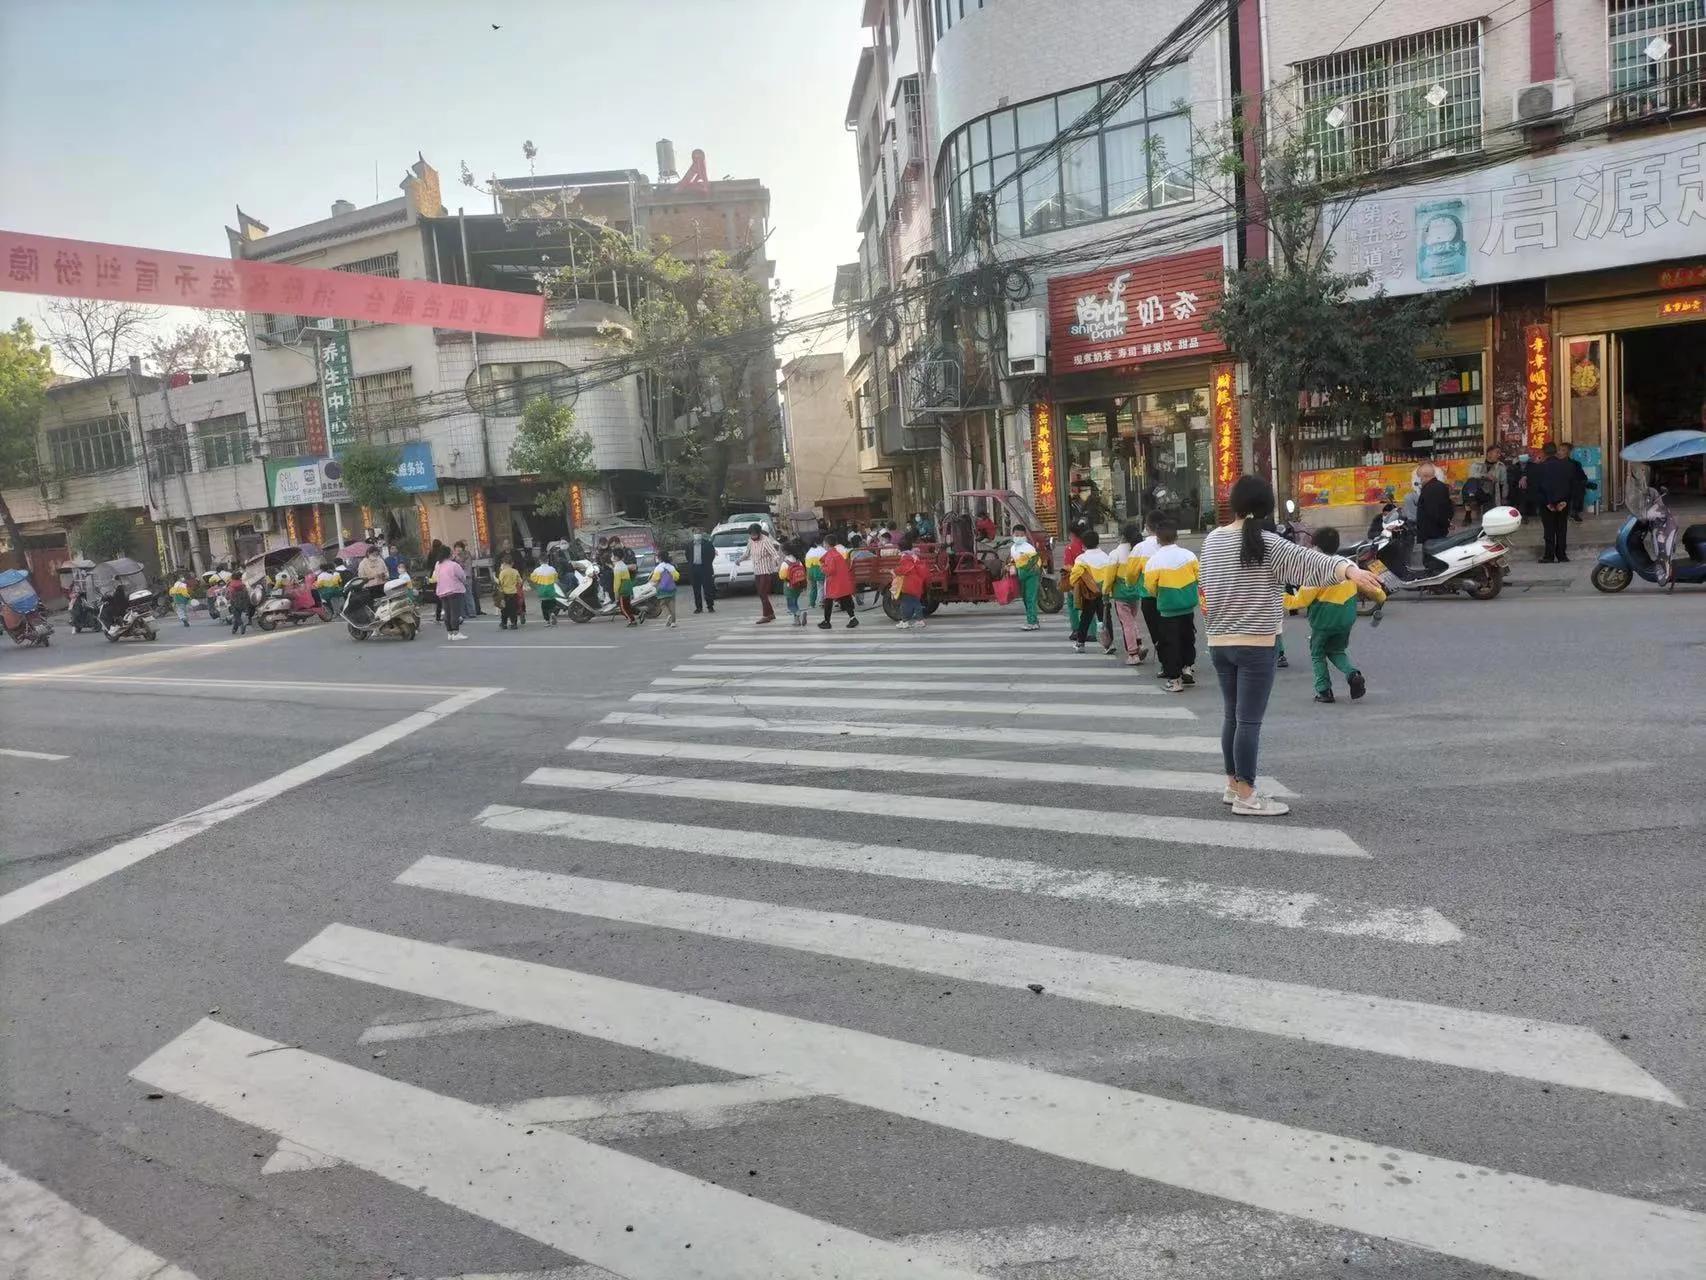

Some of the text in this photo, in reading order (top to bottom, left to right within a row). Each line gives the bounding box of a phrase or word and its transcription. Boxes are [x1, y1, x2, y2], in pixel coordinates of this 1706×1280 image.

[1118, 346, 1137, 359] 寿司
[1142, 341, 1173, 355] 鲜果饮
[1178, 337, 1200, 350] 甜品
[322, 345, 347, 435] 养生中心
